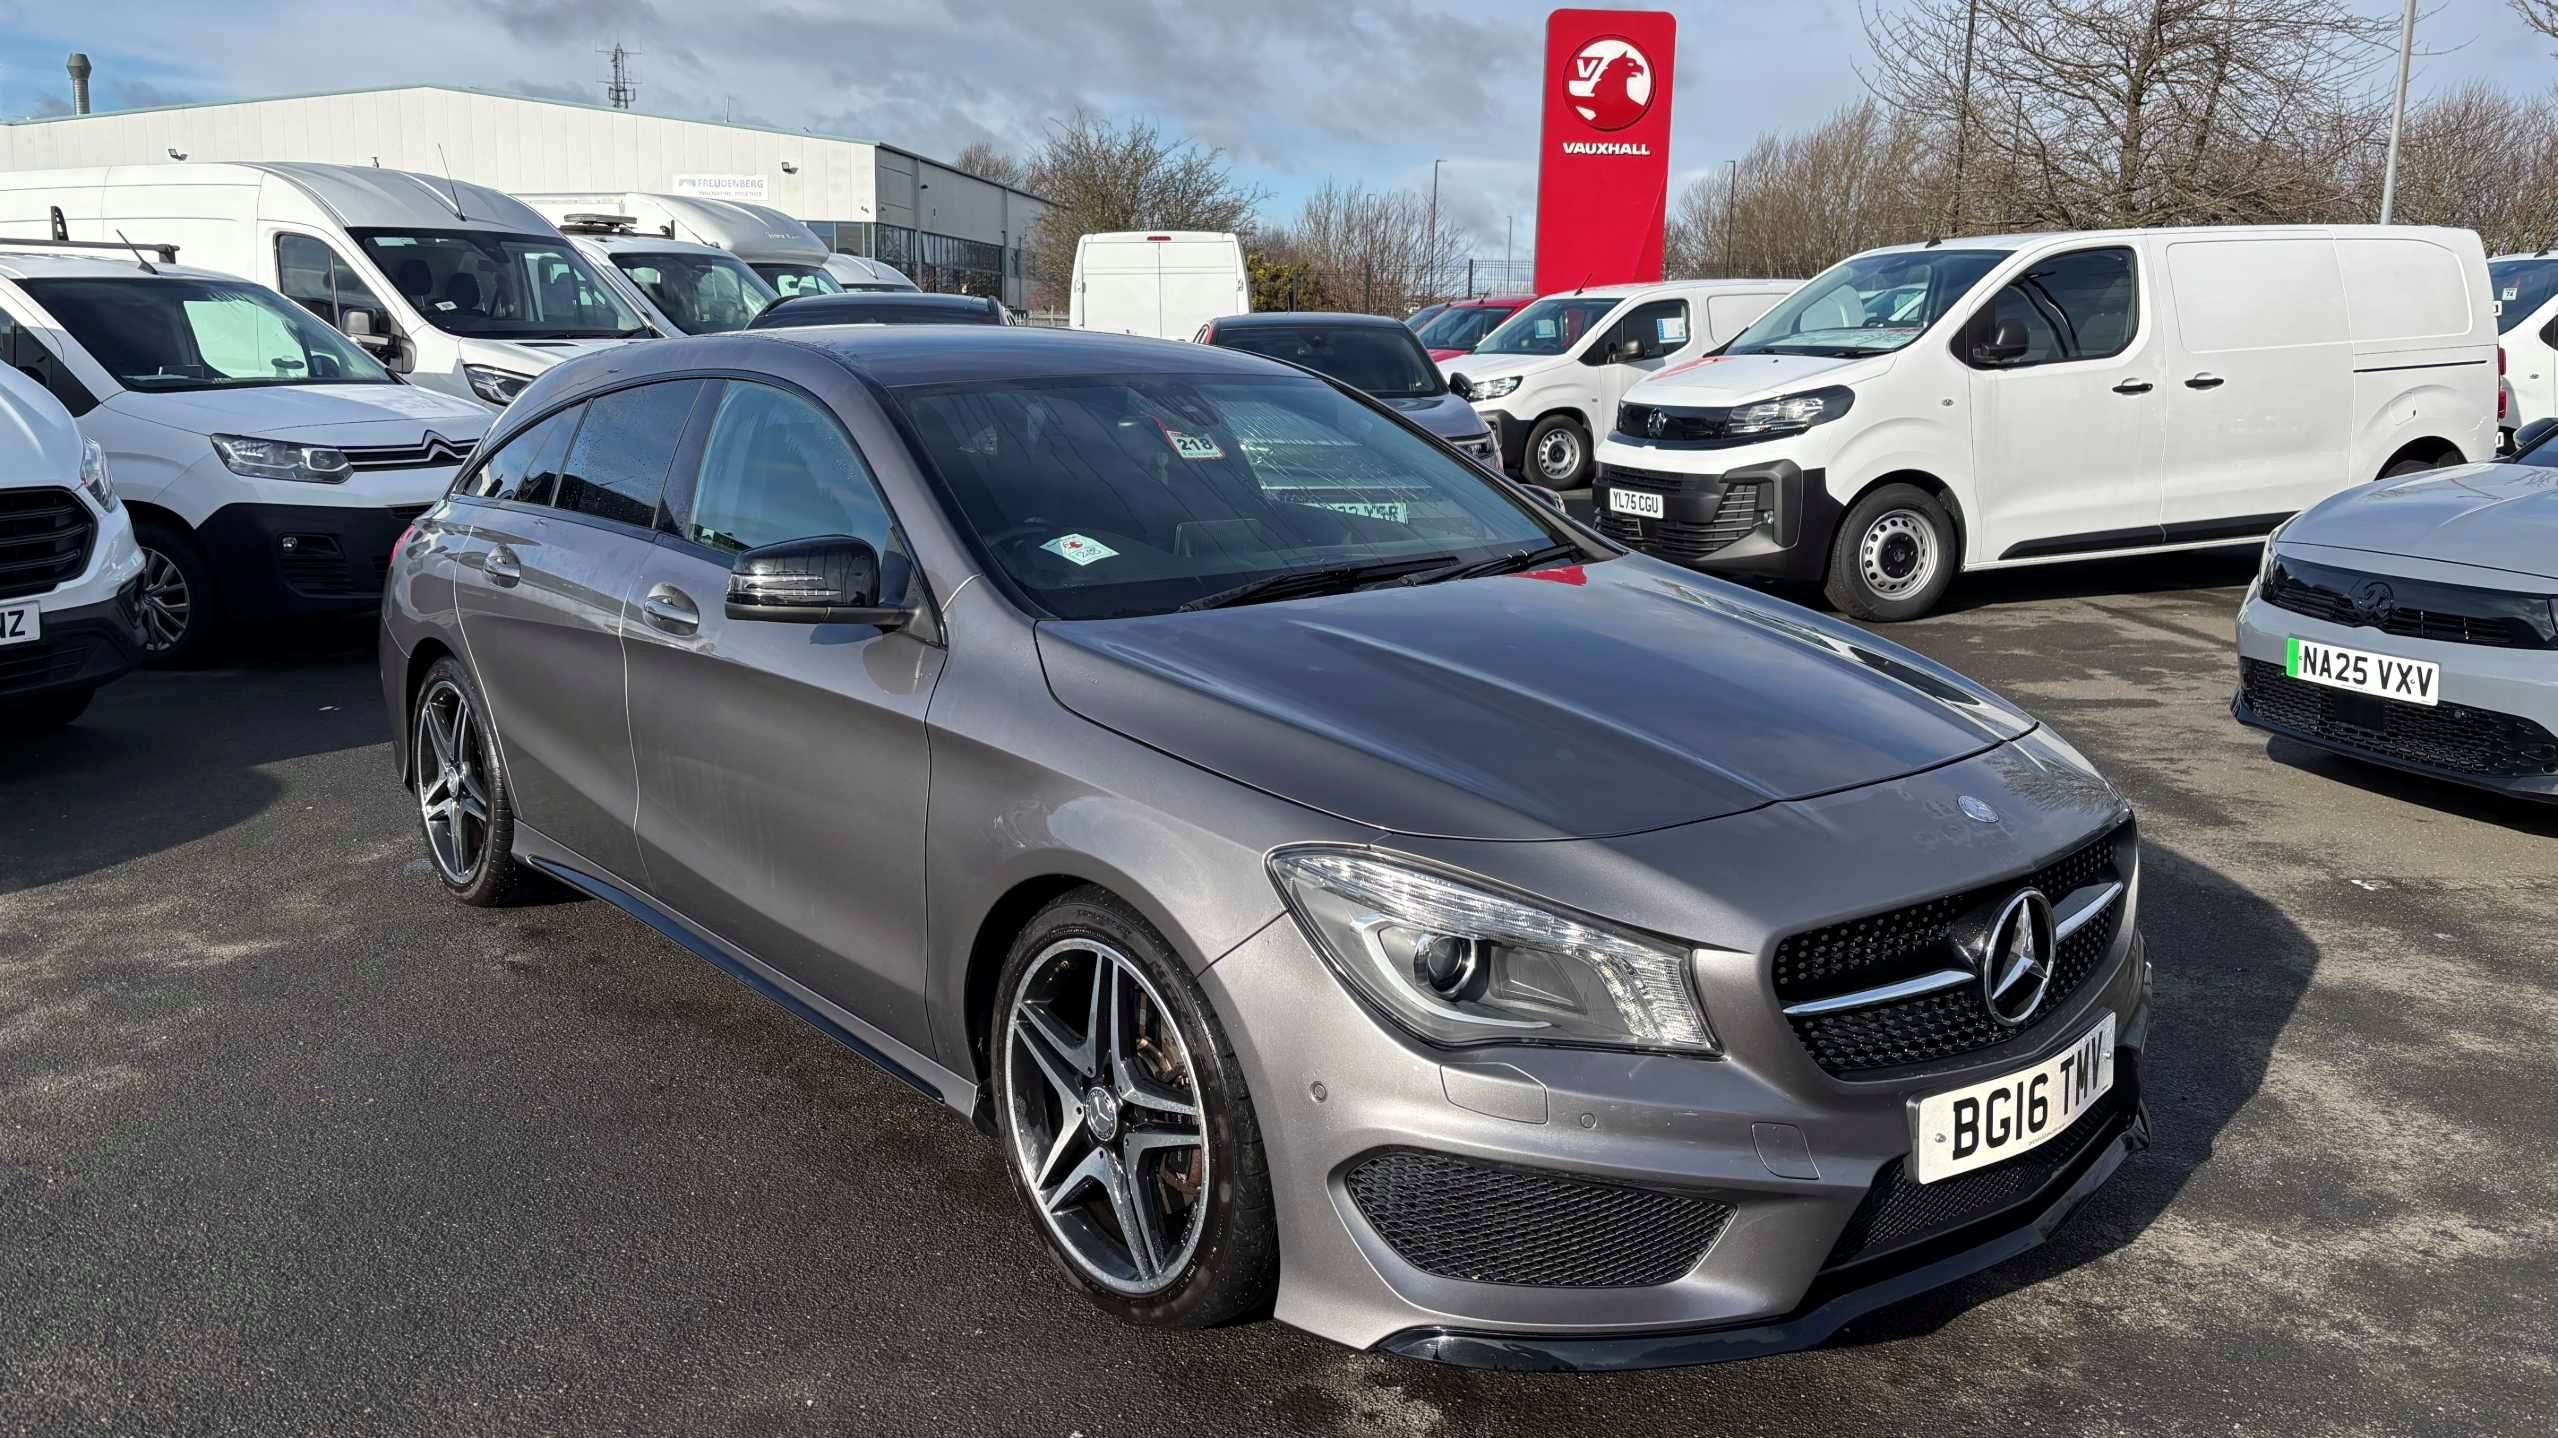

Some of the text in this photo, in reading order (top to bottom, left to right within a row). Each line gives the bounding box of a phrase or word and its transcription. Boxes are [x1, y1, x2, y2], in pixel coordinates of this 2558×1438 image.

[1563, 142, 1651, 155] VAUXHALL
[698, 178, 765, 189] FREUDENBERG
[1176, 438, 1213, 451] 218
[1613, 491, 1659, 513] YL75 CGU
[2303, 645, 2432, 697] NA25 VXV
[1952, 1031, 2103, 1161] BG16 TMV
